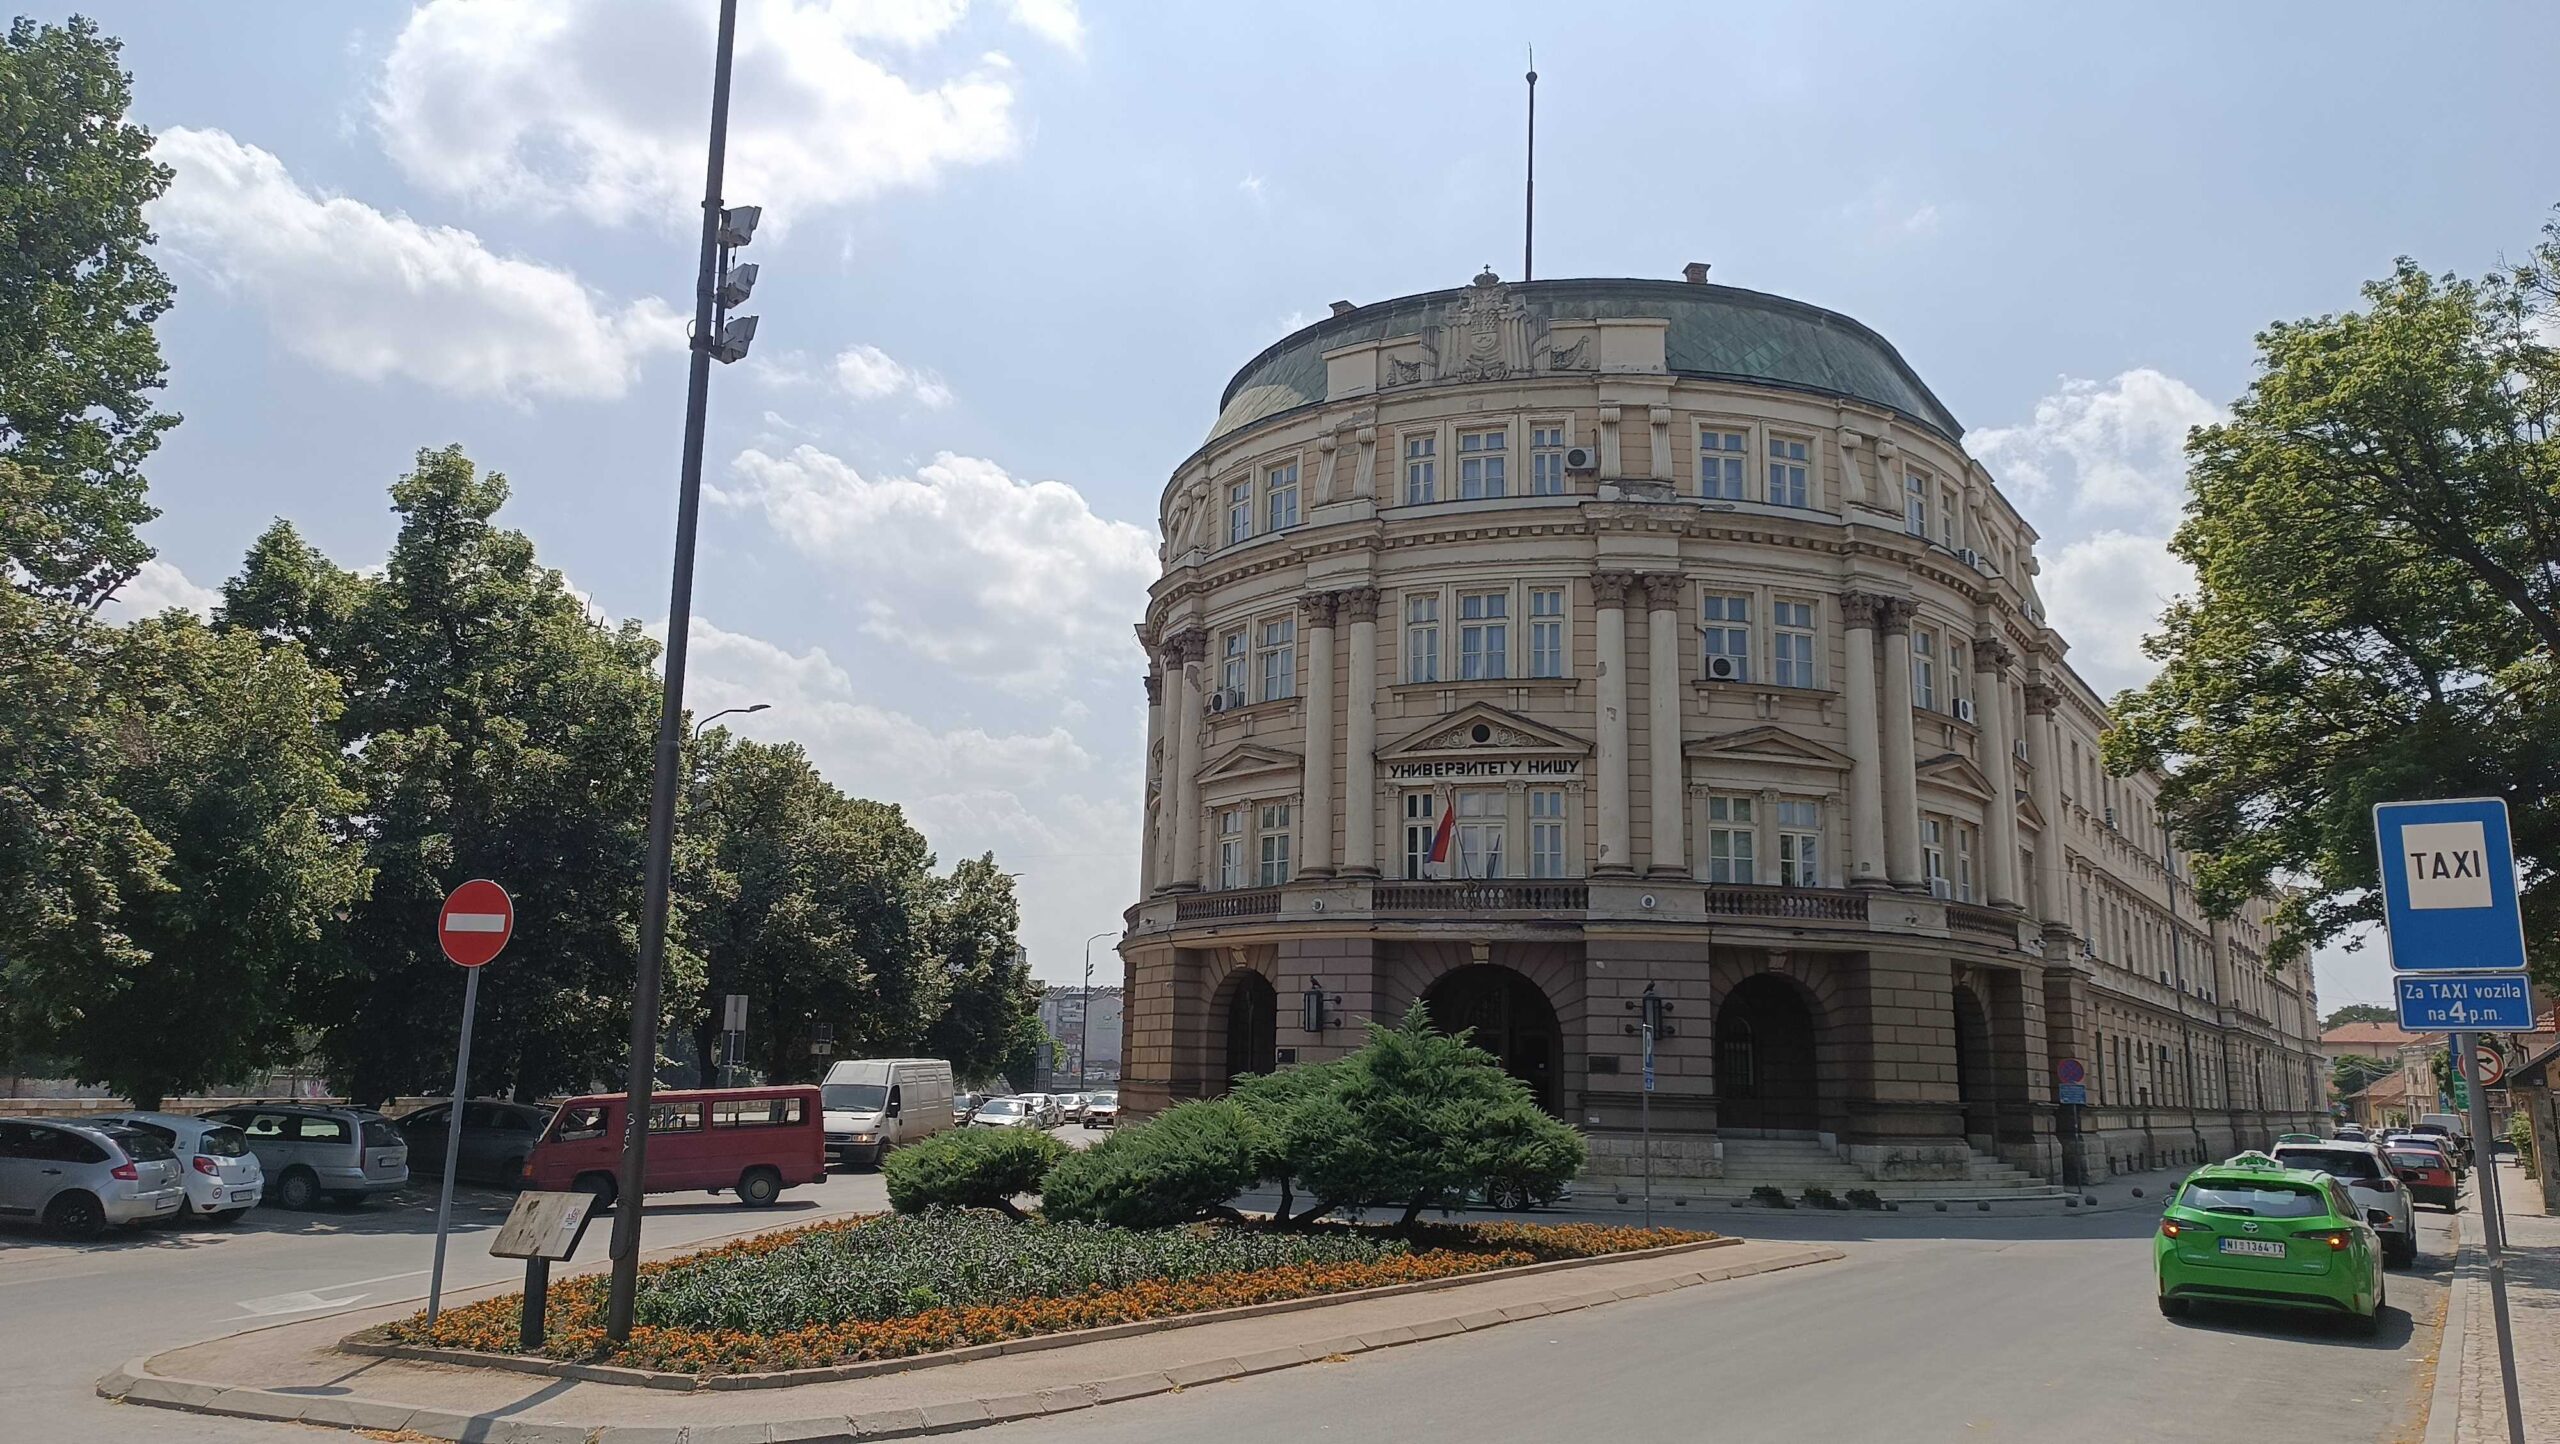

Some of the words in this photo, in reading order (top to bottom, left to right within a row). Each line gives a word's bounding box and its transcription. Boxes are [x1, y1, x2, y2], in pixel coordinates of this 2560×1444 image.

[1389, 760, 1507, 778] УНИВЕРЗИТЕТ
[1509, 760, 1523, 774] У
[1527, 759, 1580, 774] НИШУ
[2410, 850, 2481, 879] TAXI
[2404, 984, 2424, 999] Za
[2429, 983, 2468, 999] TAXI
[2474, 982, 2521, 999] vozila
[2428, 1009, 2446, 1021] na
[2449, 1000, 2467, 1023] 4
[2227, 1240, 2238, 1250] NI
